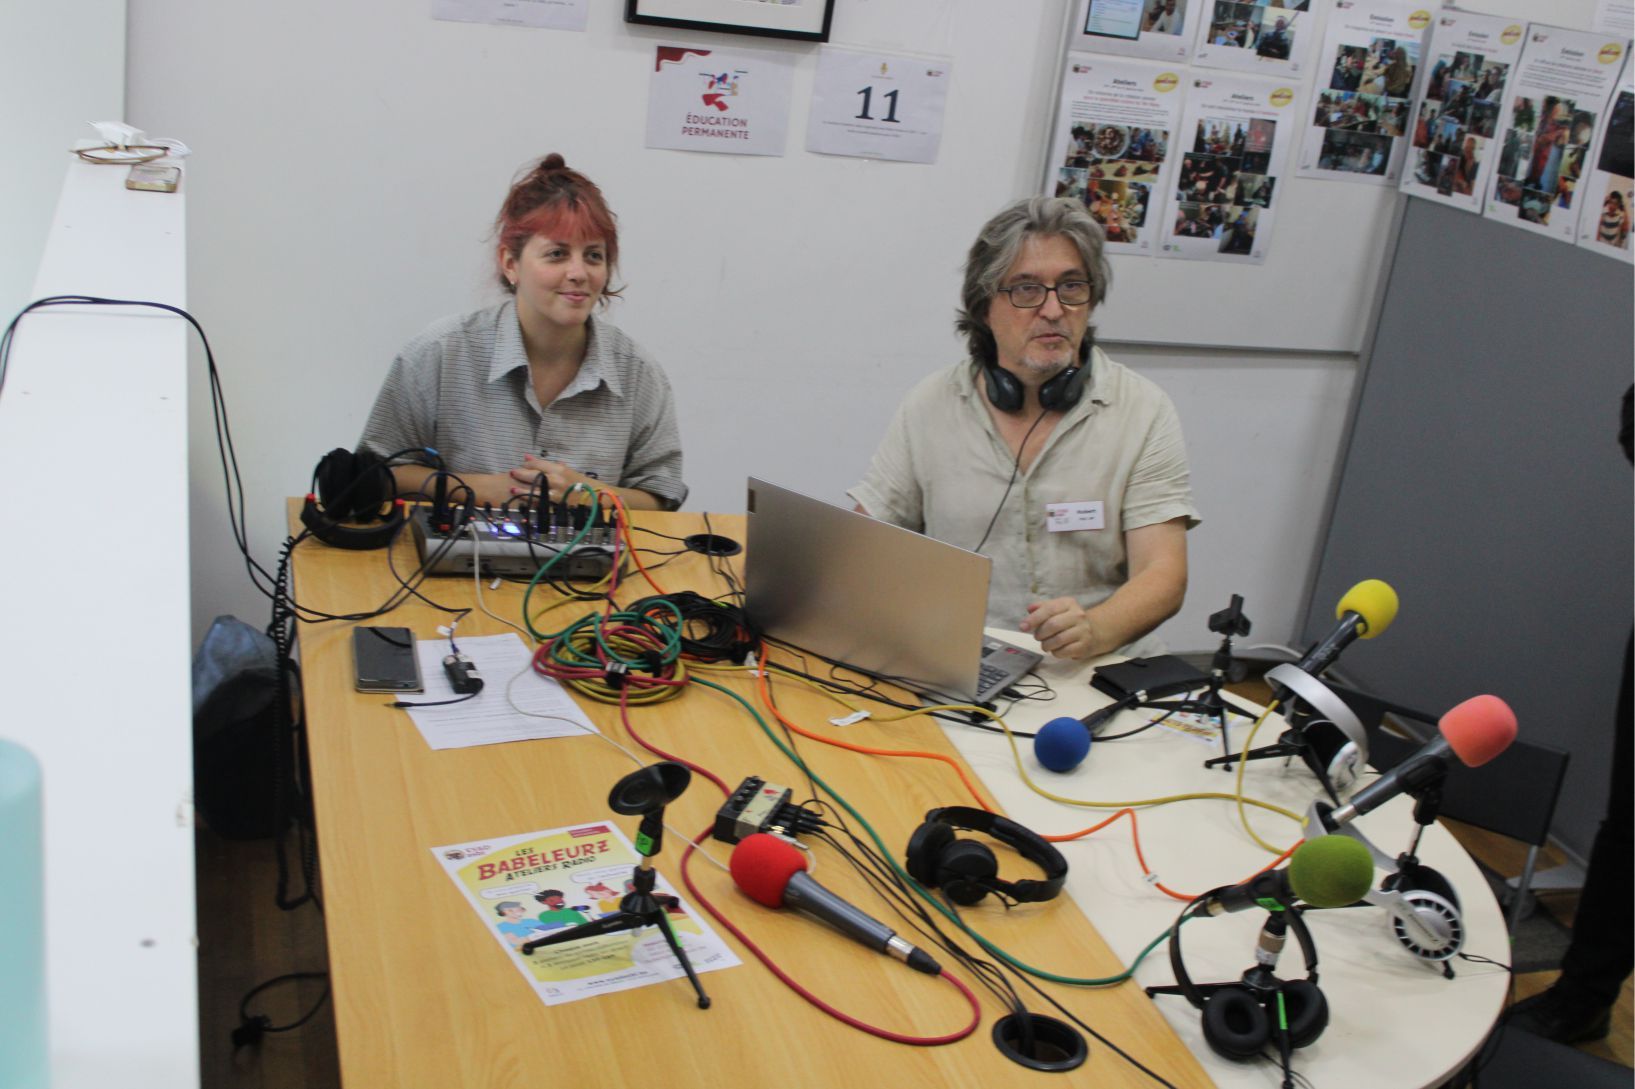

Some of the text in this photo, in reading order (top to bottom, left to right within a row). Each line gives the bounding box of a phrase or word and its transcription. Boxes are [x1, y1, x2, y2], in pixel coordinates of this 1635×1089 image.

[854, 86, 901, 123] 11
[686, 112, 748, 127] ÉDUCATION
[681, 126, 750, 140] PERMANENTE
[505, 862, 558, 882] ATELIERS
